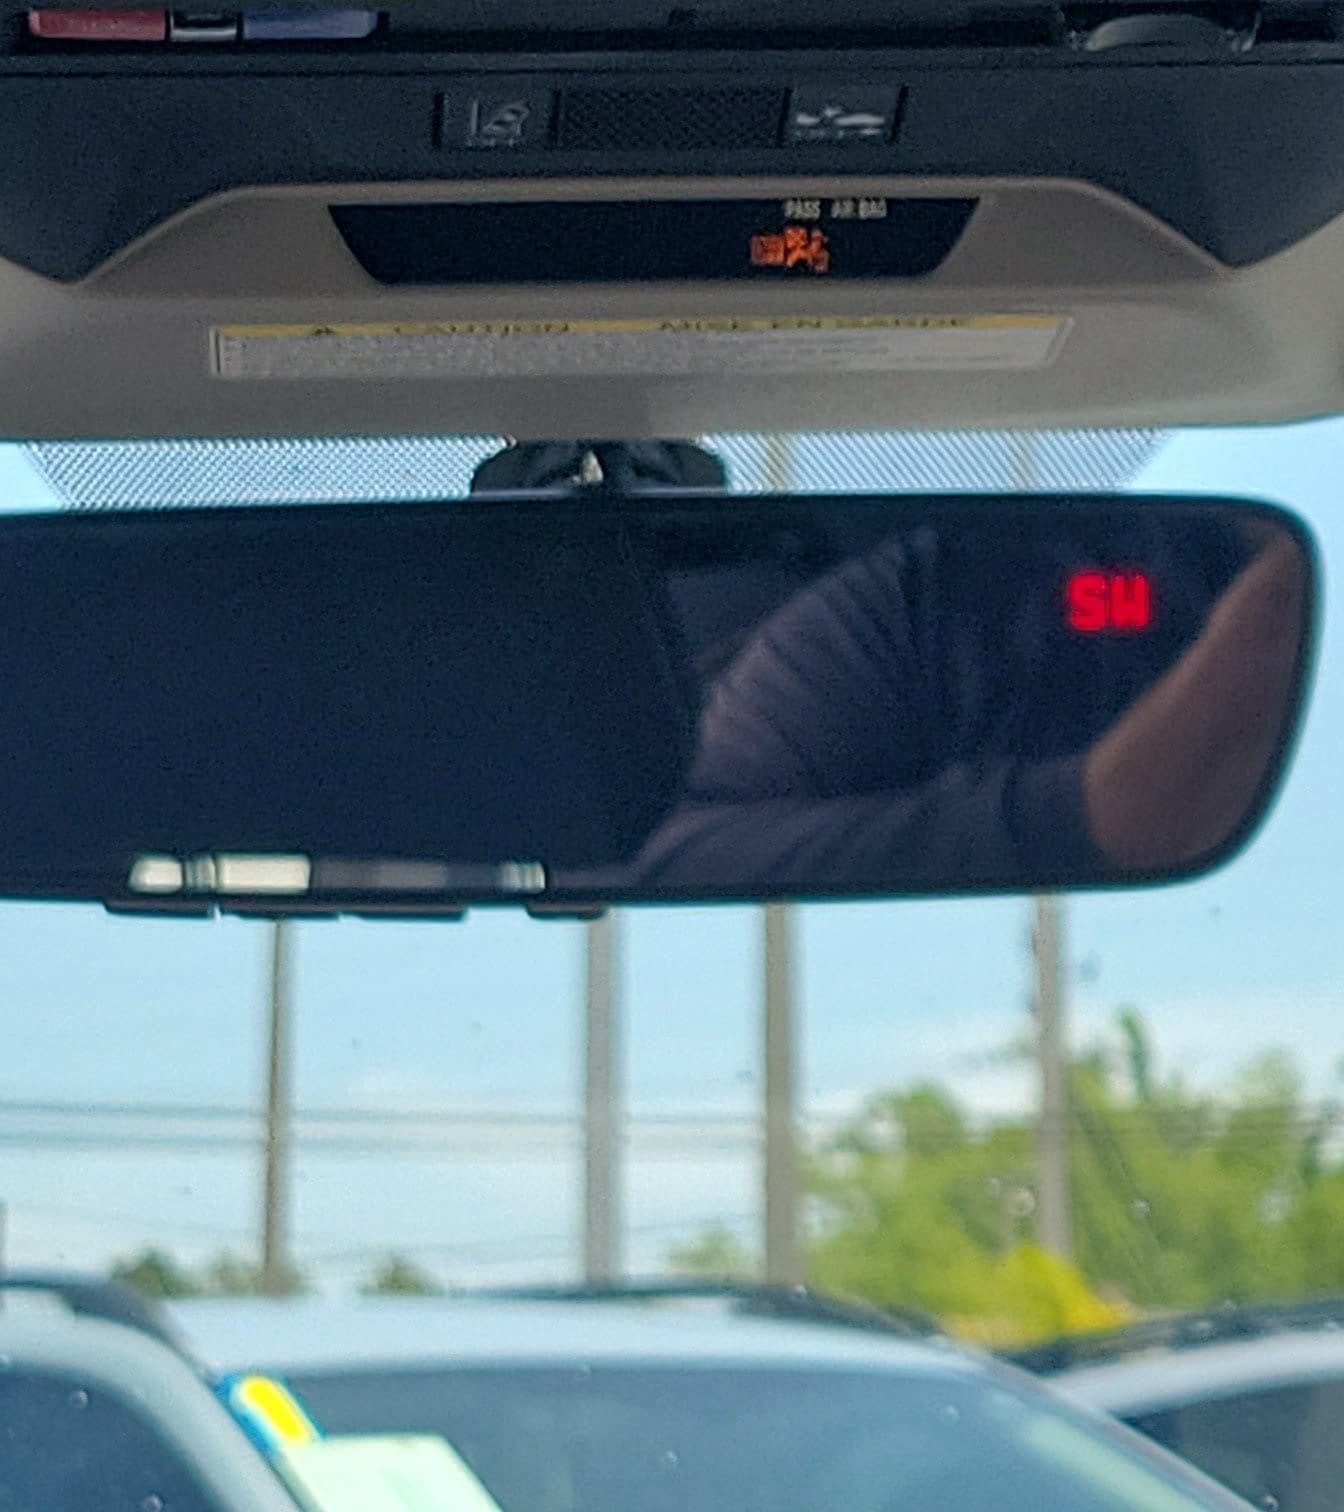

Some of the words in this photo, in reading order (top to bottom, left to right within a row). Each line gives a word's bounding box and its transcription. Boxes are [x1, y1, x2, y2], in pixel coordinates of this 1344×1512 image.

[784, 198, 821, 220] PASS
[830, 199, 856, 219] AIR
[858, 198, 888, 220] BAG
[1068, 572, 1150, 631] SW
